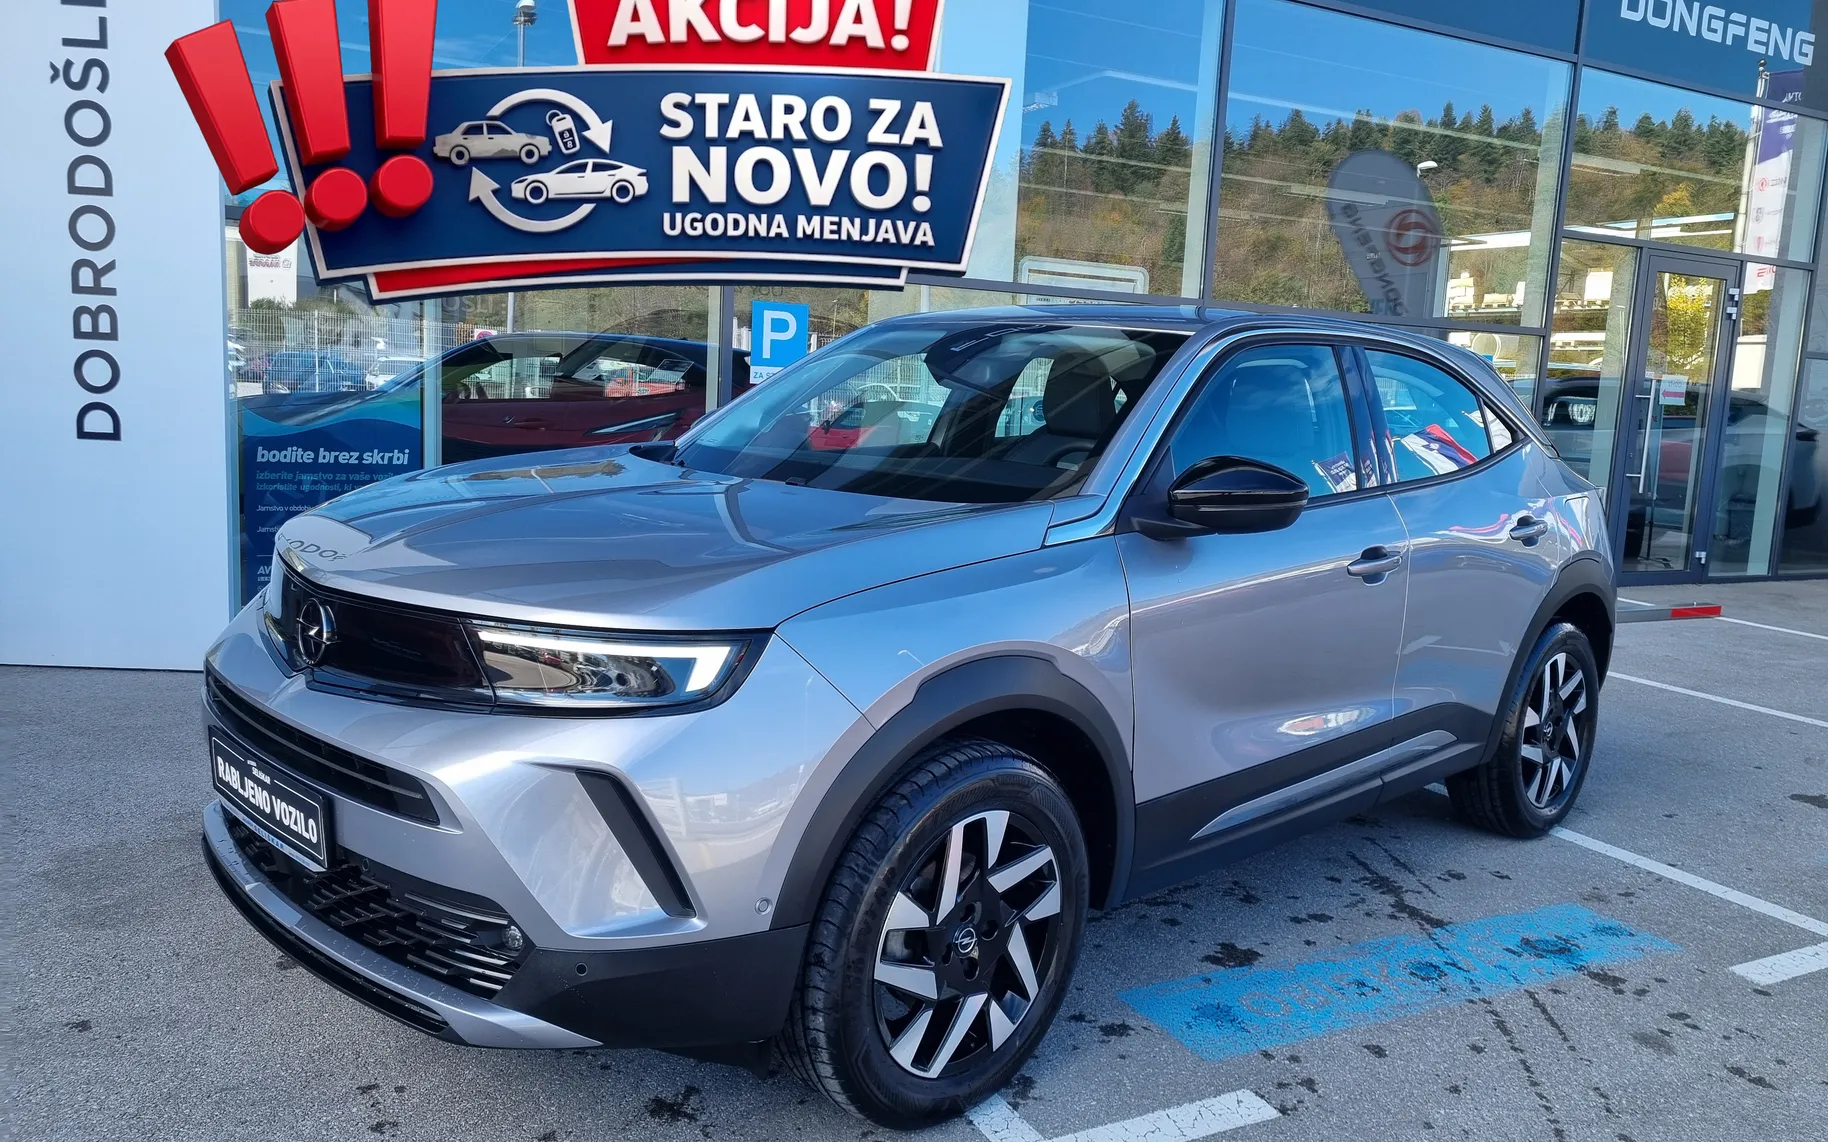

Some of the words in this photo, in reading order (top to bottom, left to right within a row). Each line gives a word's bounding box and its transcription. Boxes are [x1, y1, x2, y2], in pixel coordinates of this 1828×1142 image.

[1620, 0, 1816, 67] DONGFENG
[50, 0, 122, 442] DOBRODOŠLI
[762, 310, 797, 359] P
[753, 371, 764, 379] ZA
[256, 446, 315, 463] bodite
[318, 448, 360, 464] brez
[362, 449, 410, 465] skrbi
[256, 470, 294, 480] izberite
[295, 471, 333, 482] jamstvo
[335, 473, 347, 481] za
[349, 472, 370, 481] vaše
[256, 483, 298, 491] izkoristite
[299, 483, 342, 493] ugodnosti,
[217, 755, 271, 814] RABLJENO
[271, 795, 317, 844] VOZILO
